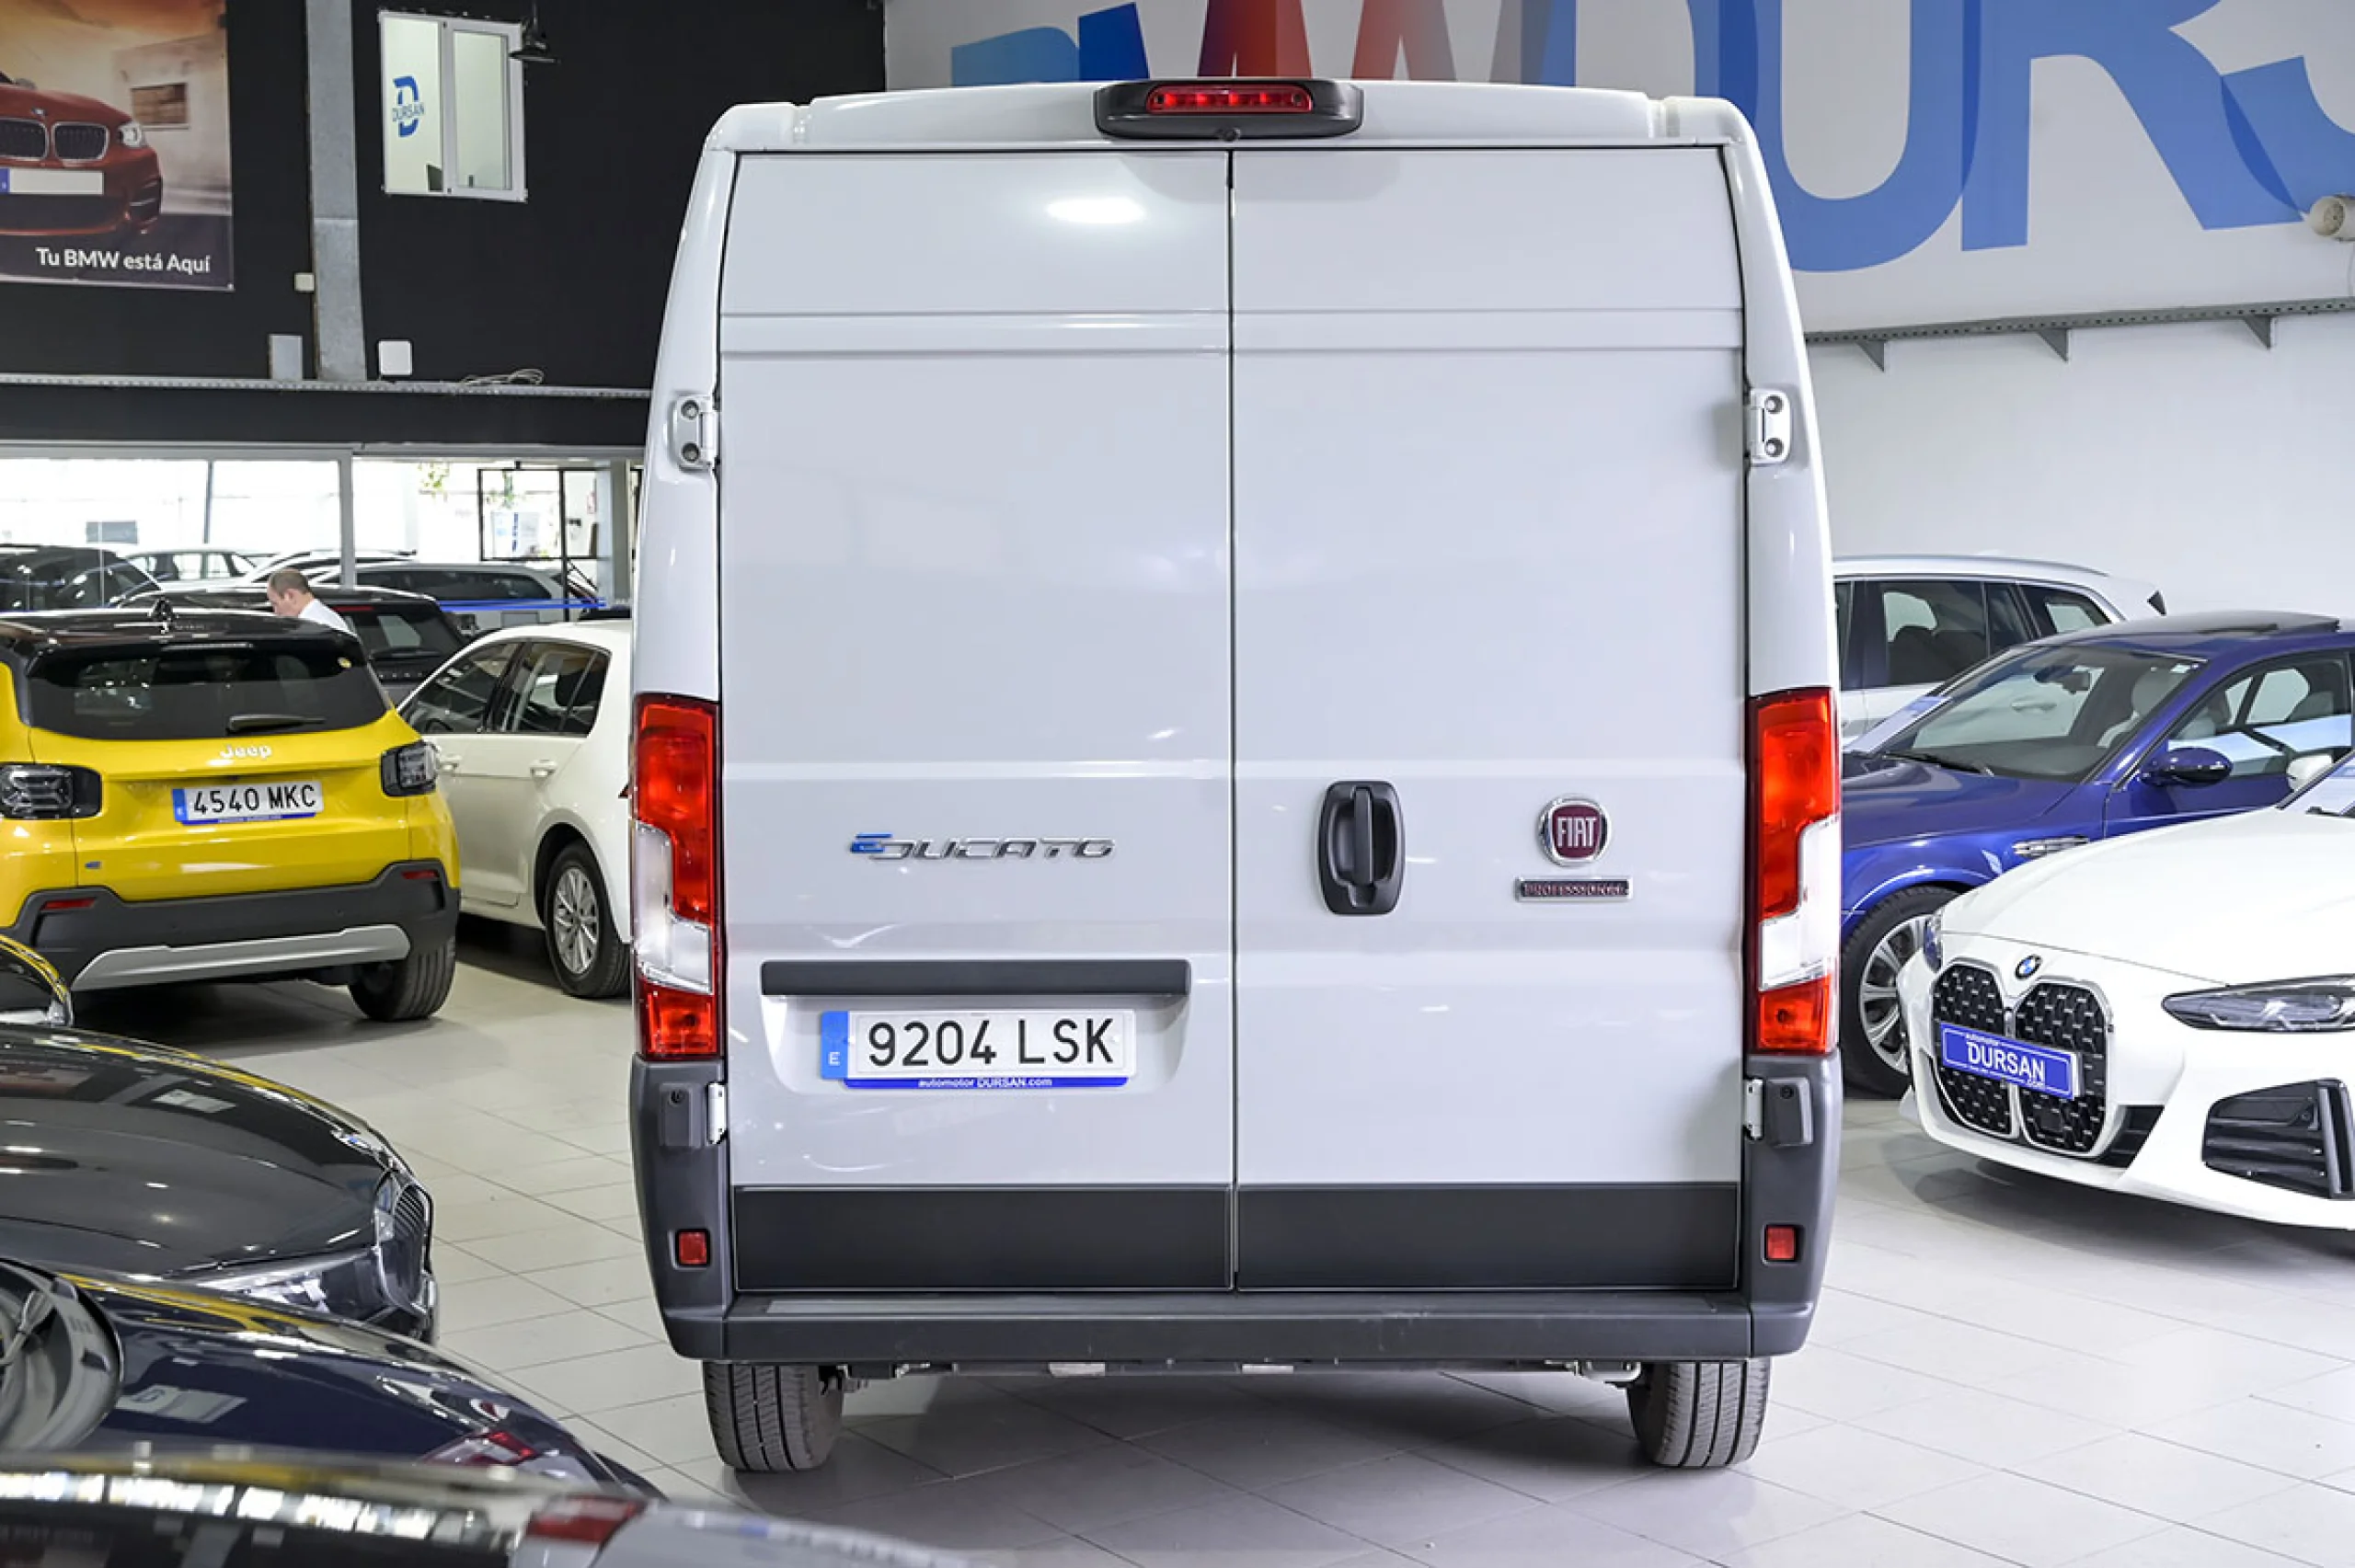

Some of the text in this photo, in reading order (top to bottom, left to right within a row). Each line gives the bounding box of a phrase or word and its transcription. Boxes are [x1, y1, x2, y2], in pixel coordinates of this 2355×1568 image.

[35, 247, 211, 275] Tu BMW está Aquí
[220, 745, 272, 760] Jeep
[194, 784, 316, 815] 4540 MKC
[1557, 817, 1597, 848] FIAT
[868, 1018, 1113, 1066] 9204 LSK
[829, 1051, 840, 1066] E
[1966, 1041, 2046, 1083] DURSAN
